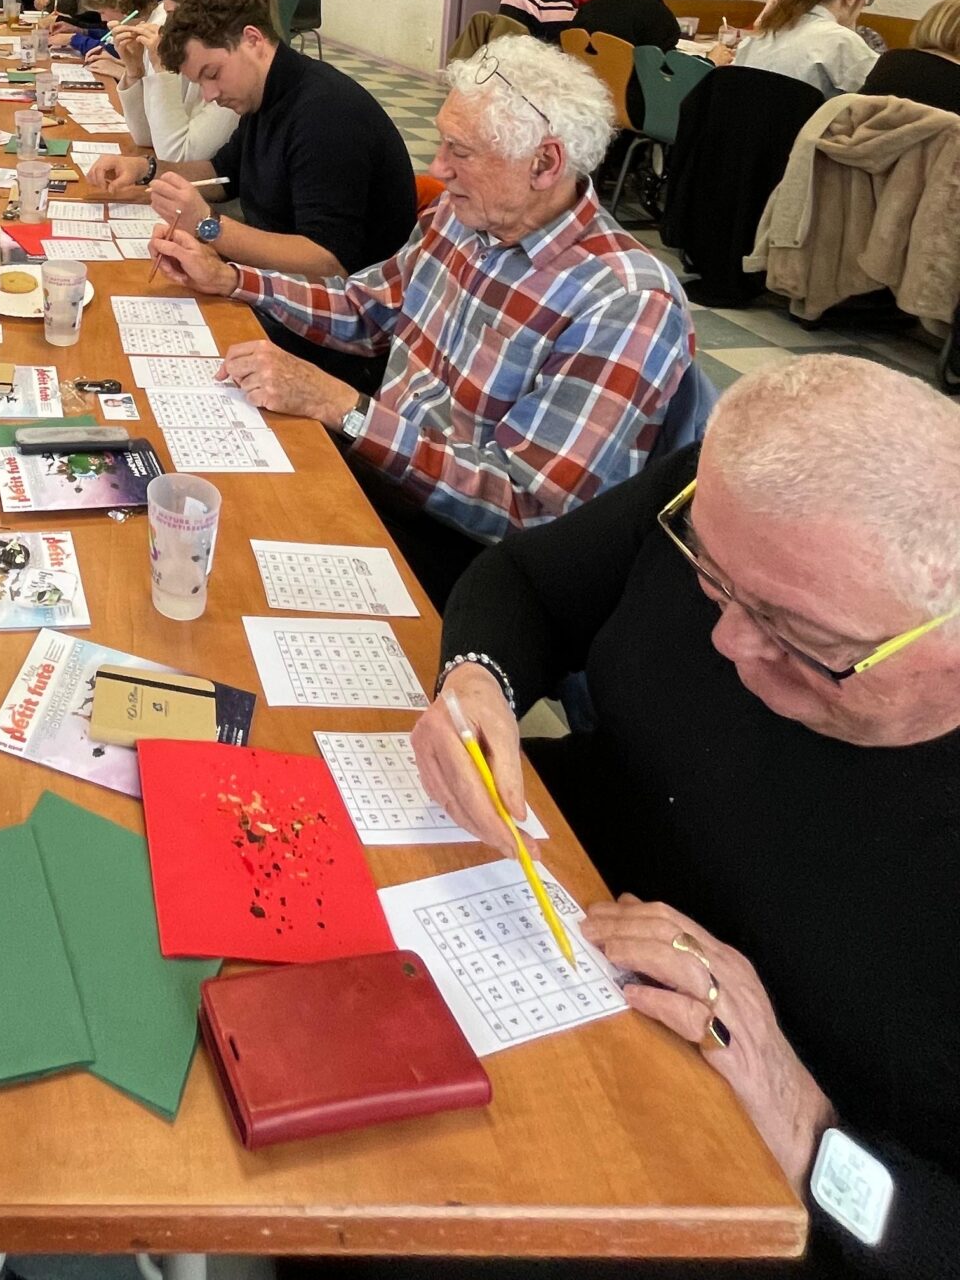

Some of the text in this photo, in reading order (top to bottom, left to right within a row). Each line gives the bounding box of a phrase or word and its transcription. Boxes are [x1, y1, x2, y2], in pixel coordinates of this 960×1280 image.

[4, 698, 39, 743] petit
[337, 738, 345, 748] 61
[377, 739, 387, 748] 64
[400, 739, 408, 748] 70
[388, 756, 395, 766] 57
[352, 775, 361, 785] 32
[374, 775, 383, 785] 31
[361, 794, 371, 804] 21
[382, 794, 392, 804] 23
[405, 793, 413, 803] 16
[369, 814, 378, 824] 10
[392, 814, 400, 823] 14
[480, 900, 492, 912] 61
[435, 912, 448, 924] 63
[497, 922, 510, 935] 50
[453, 935, 466, 948] 54
[521, 889, 612, 999] 12 17 74
[502, 894, 591, 1007] 10 18 36 58 75
[458, 906, 543, 1020] 11 28 34 48 64
[471, 961, 484, 974] 31
[536, 973, 547, 985] 16
[488, 987, 503, 1001] 22
